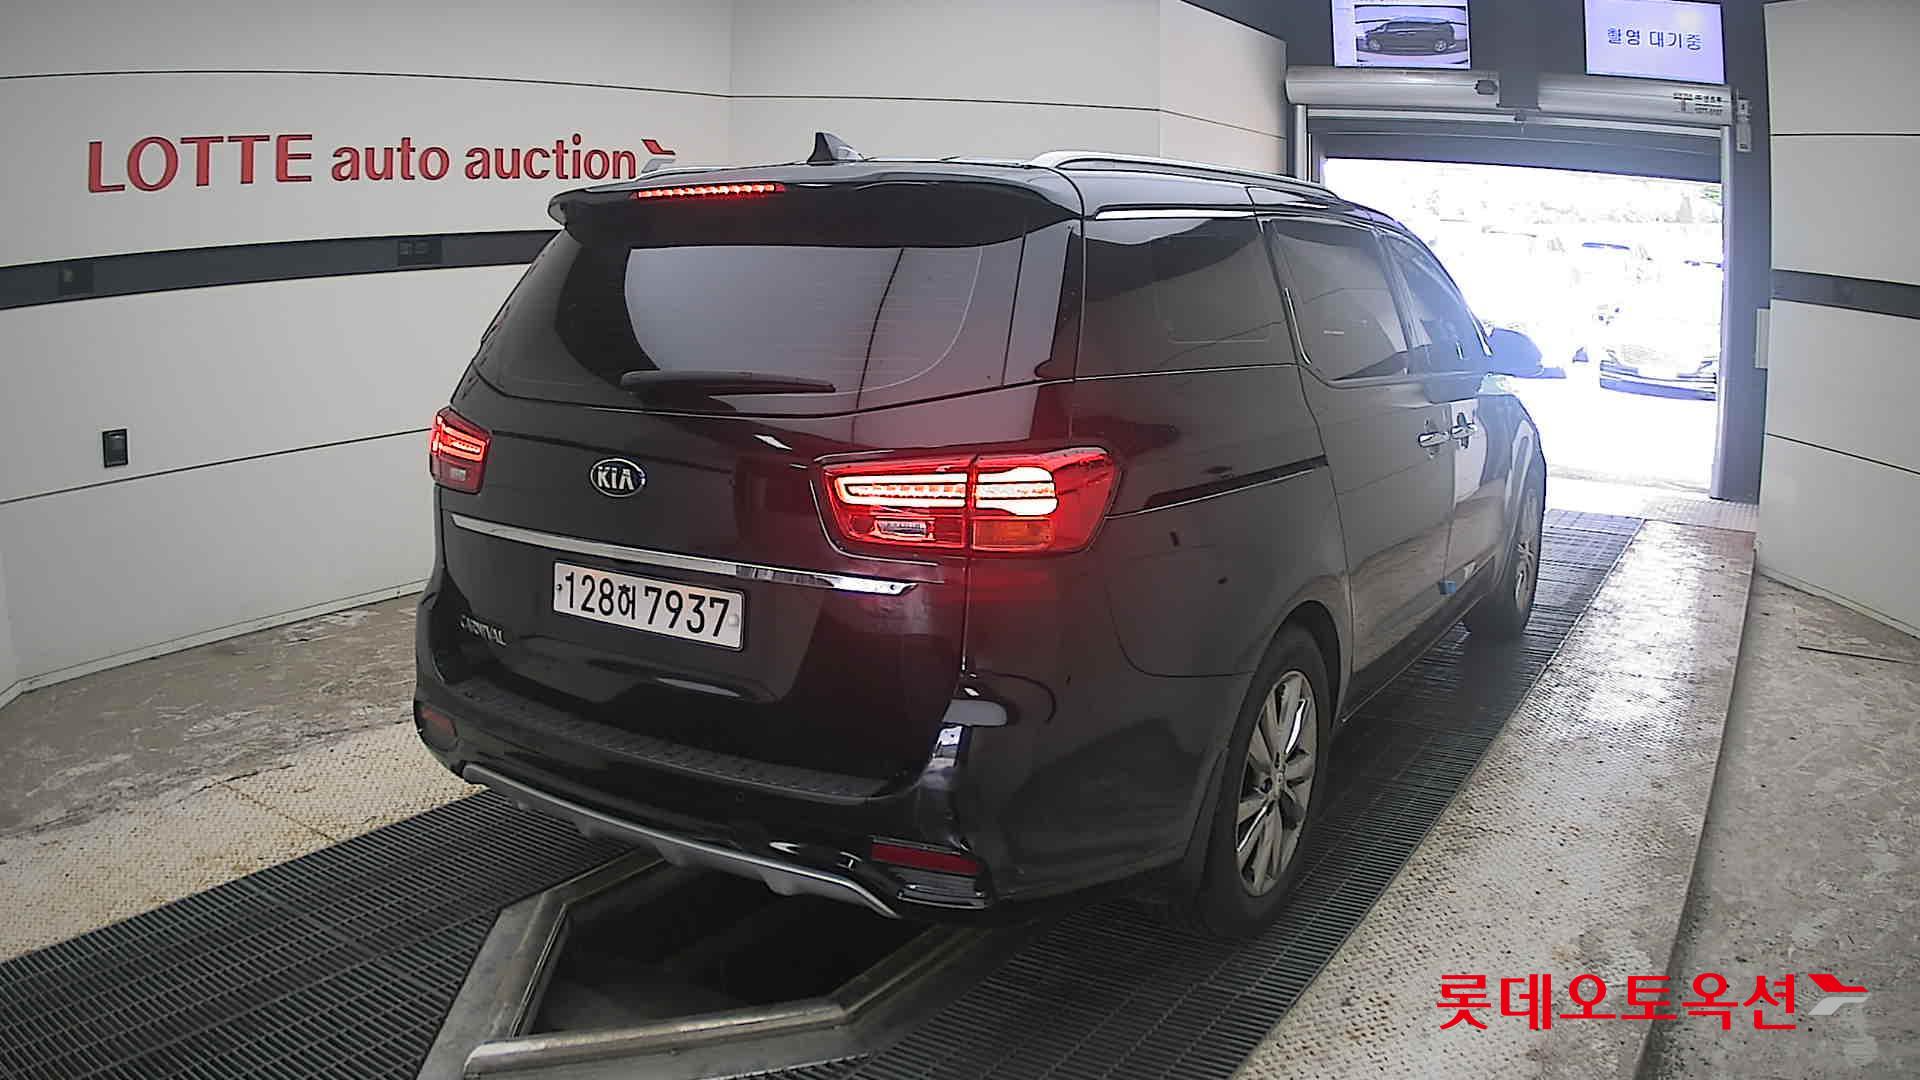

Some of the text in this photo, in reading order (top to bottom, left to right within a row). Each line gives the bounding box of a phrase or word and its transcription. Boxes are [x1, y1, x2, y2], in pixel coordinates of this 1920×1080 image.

[1648, 31, 1701, 50] 대기중
[87, 133, 636, 193] LOTTE auto auction
[597, 464, 635, 490] KIA
